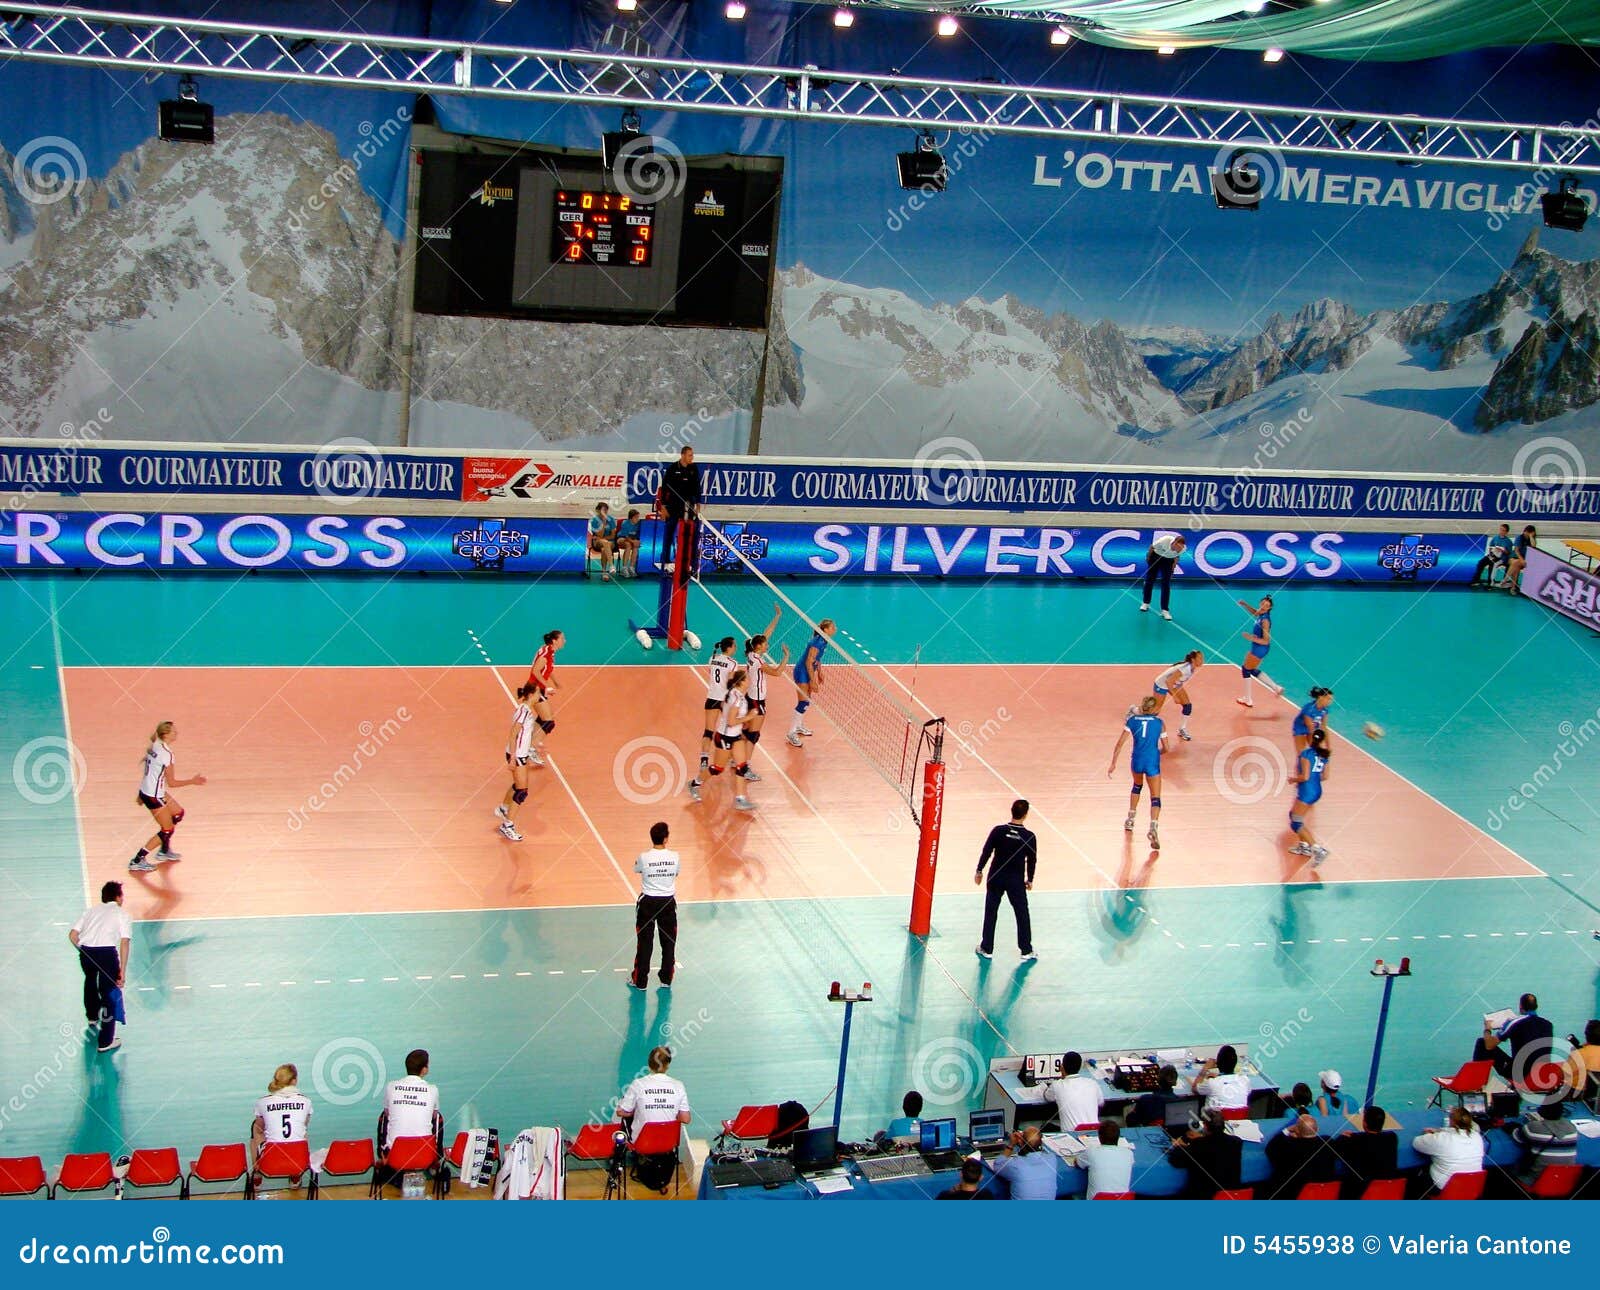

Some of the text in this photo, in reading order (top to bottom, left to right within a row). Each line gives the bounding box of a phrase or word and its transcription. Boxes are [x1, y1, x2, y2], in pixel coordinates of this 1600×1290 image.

[1032, 150, 1264, 200] L'OTTA
[582, 195, 630, 211] 0 2
[561, 213, 582, 221] GER
[694, 207, 725, 216] events
[628, 216, 647, 224] ITA
[574, 223, 582, 237] 7
[639, 227, 649, 241] 9
[571, 244, 581, 258] 0
[635, 248, 645, 261] 0
[120, 455, 283, 487] COURMAYEUR
[299, 459, 454, 493] COURMAYEUR
[545, 474, 624, 488] AIRVALLEE
[791, 471, 930, 501] COURMAYEUR
[944, 475, 1077, 504] COURMAYEUR
[1090, 479, 1218, 508] COURMAYEUR
[1230, 483, 1354, 510] COURMAYEUR
[1366, 486, 1485, 513] COURMAYEUR
[84, 513, 408, 568] CROSS
[461, 530, 522, 543] SILVER
[459, 545, 523, 559] CROSS
[808, 524, 1075, 575] SILVER
[1386, 544, 1434, 556] SILVER
[1382, 557, 1433, 569] CROSS
[715, 668, 721, 684] 8
[1028, 1058, 1062, 1073] 0 7 9
[394, 1085, 428, 1093] VOLLEYBALL
[267, 1102, 305, 1113] KAUFFELDT
[281, 1114, 292, 1139] 5
